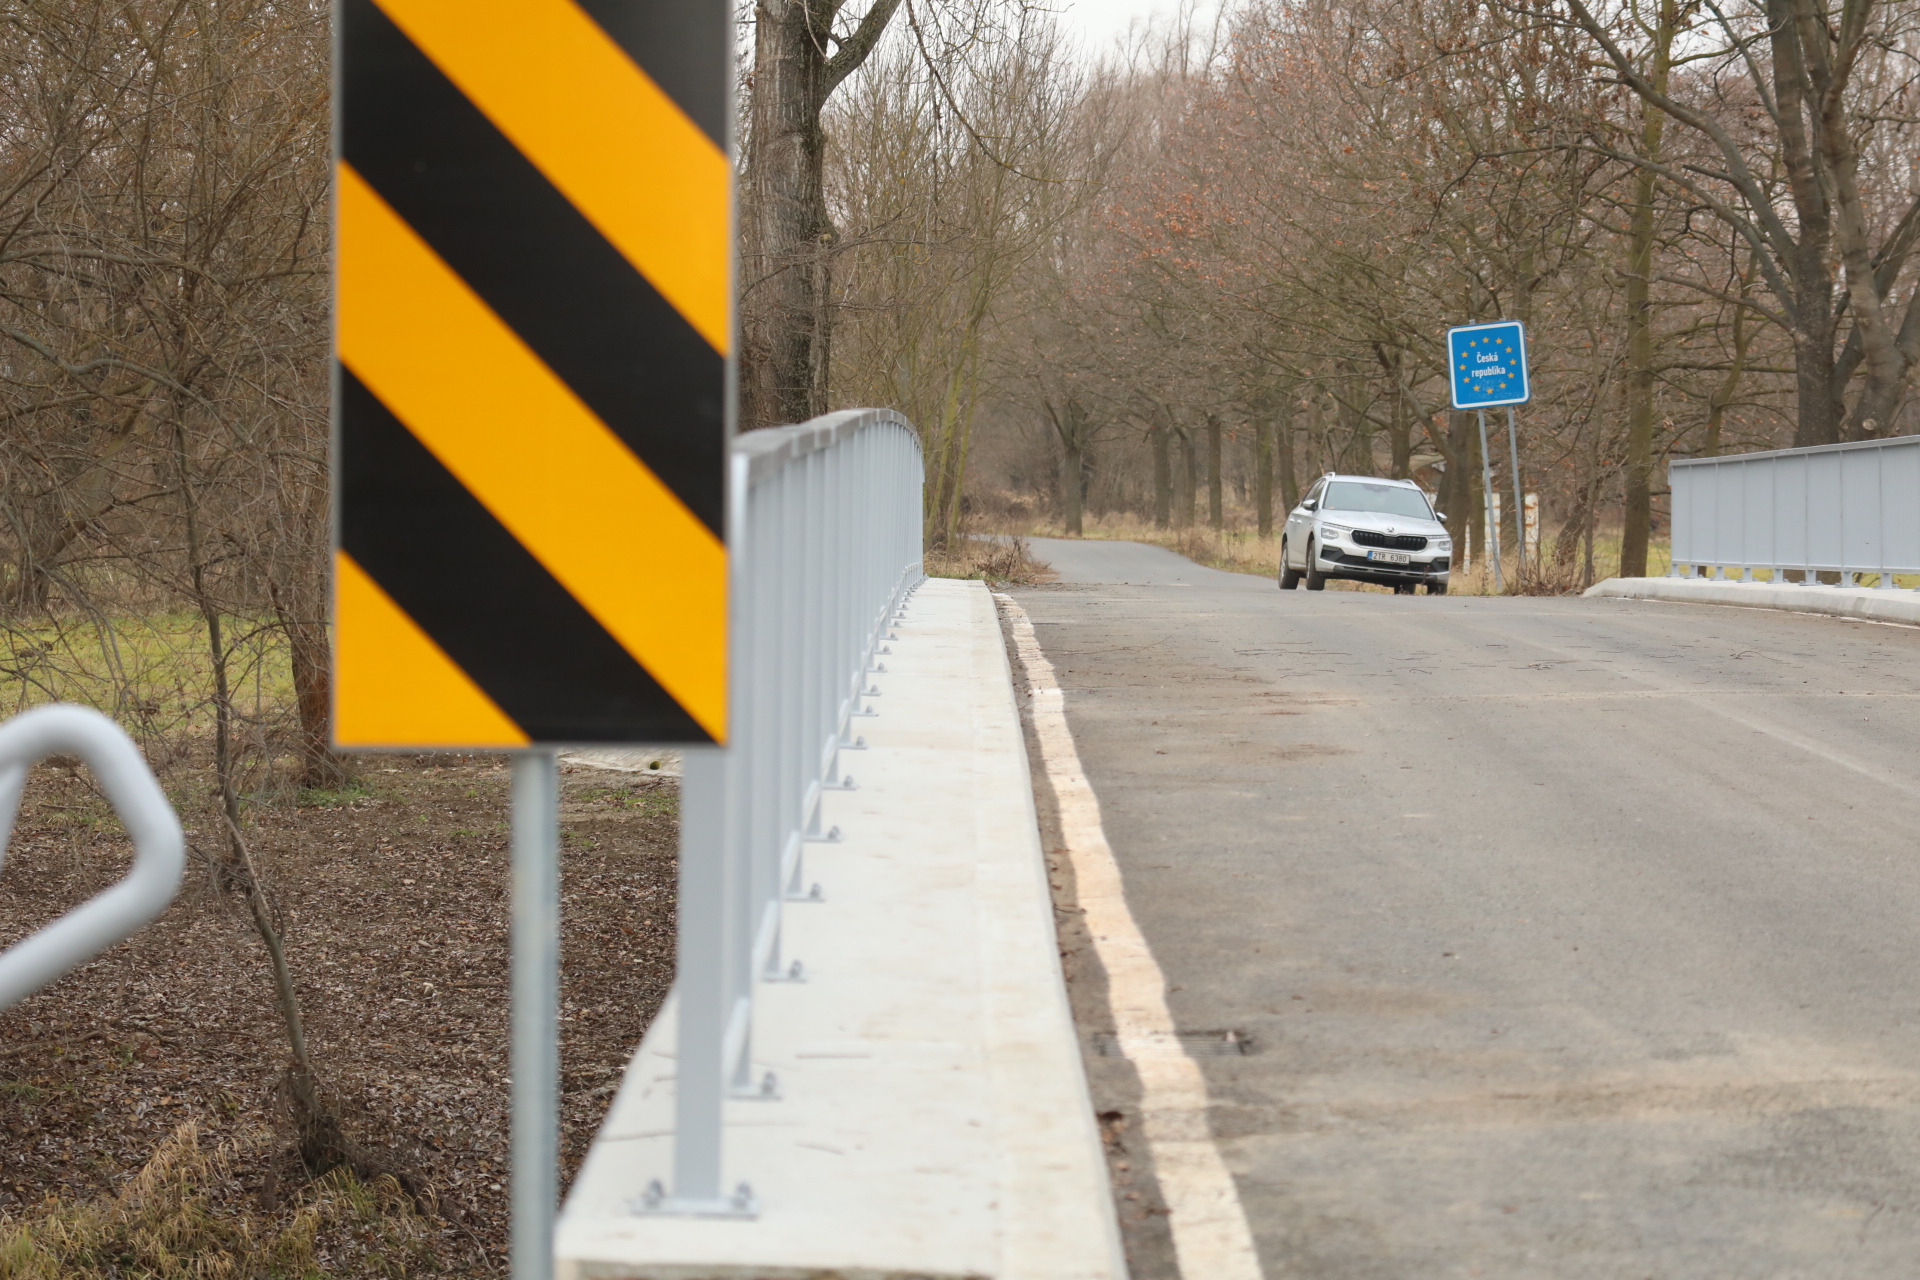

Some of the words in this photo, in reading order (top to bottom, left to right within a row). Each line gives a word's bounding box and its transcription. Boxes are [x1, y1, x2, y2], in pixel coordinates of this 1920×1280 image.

[1476, 352, 1498, 363] Česká
[1471, 366, 1506, 379] republika
[1390, 554, 1407, 562] 6380
